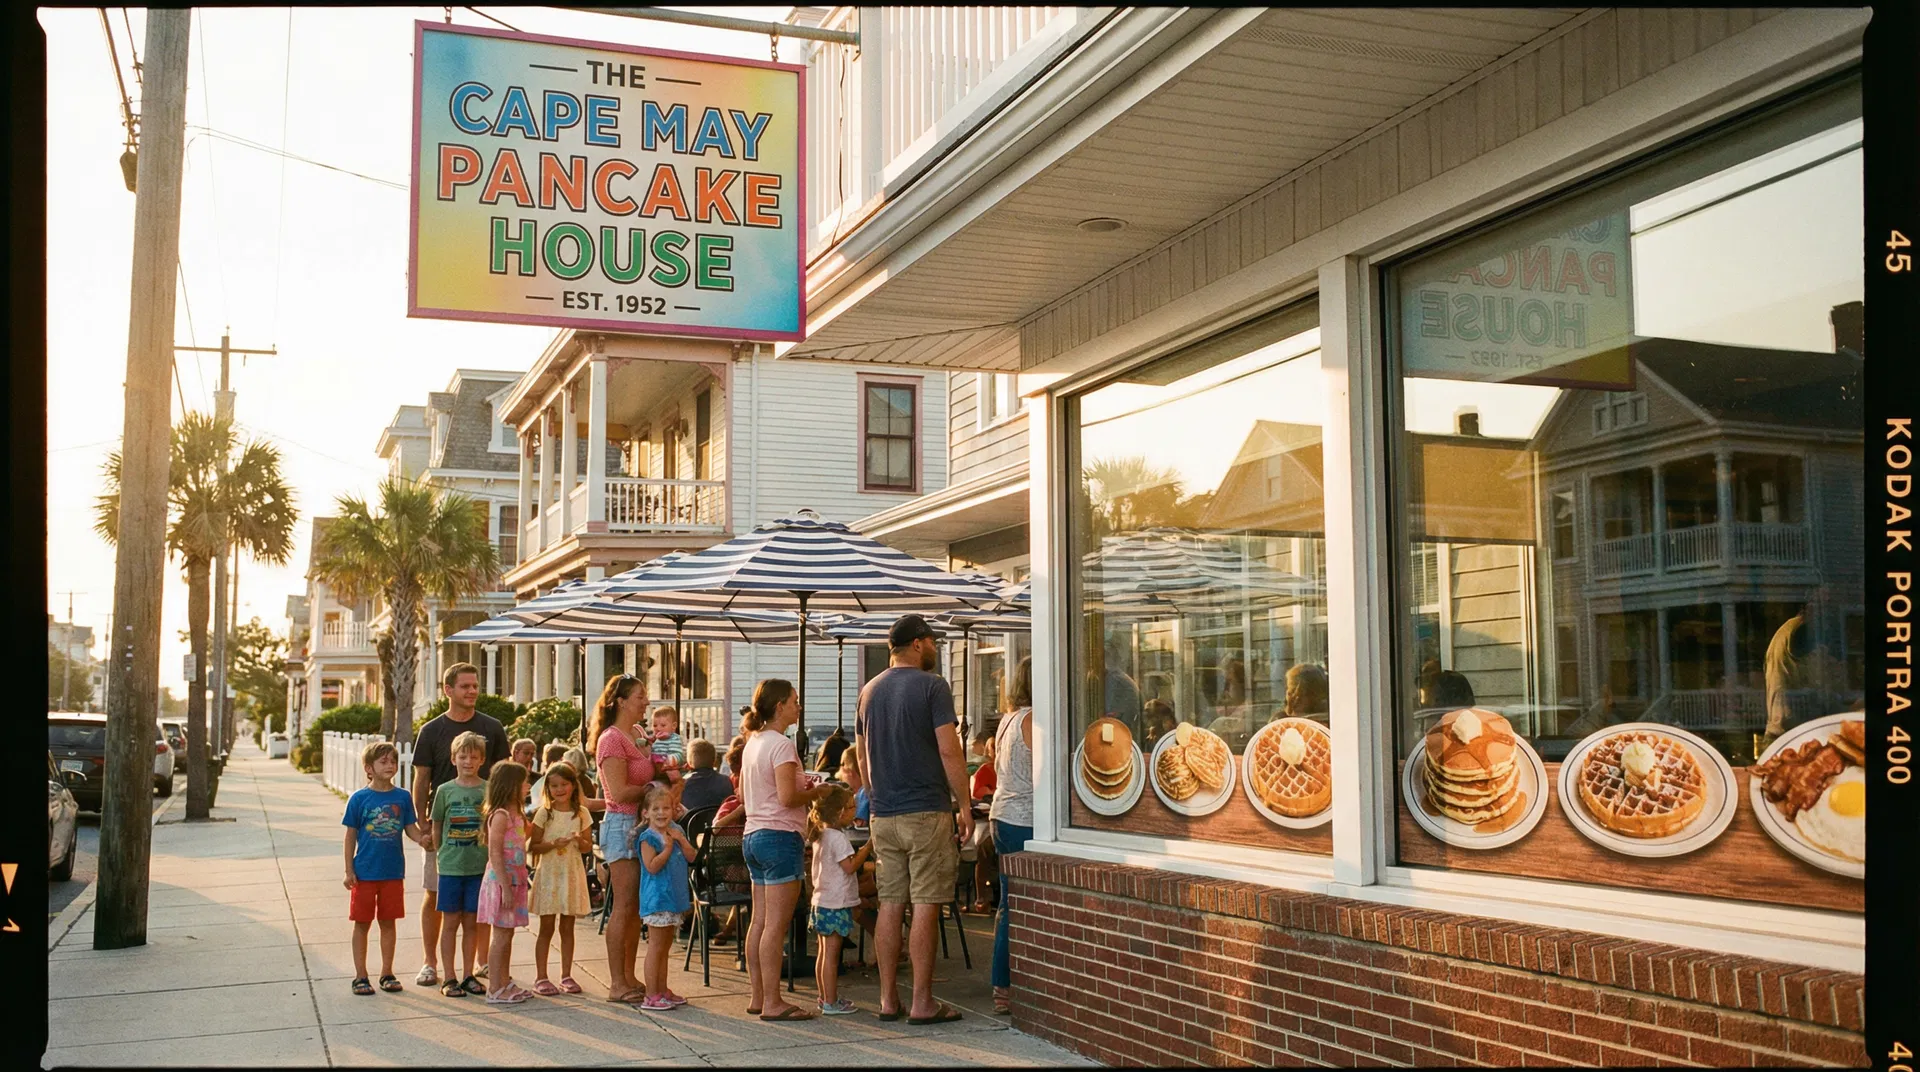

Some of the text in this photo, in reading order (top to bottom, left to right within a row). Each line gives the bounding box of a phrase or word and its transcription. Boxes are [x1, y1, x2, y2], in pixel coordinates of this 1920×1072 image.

[586, 60, 646, 89] THE
[449, 82, 773, 161] CAPE MAY
[437, 143, 783, 229] PANCAKE
[489, 217, 735, 292] HOUSE
[562, 290, 667, 316] EST. 1952
